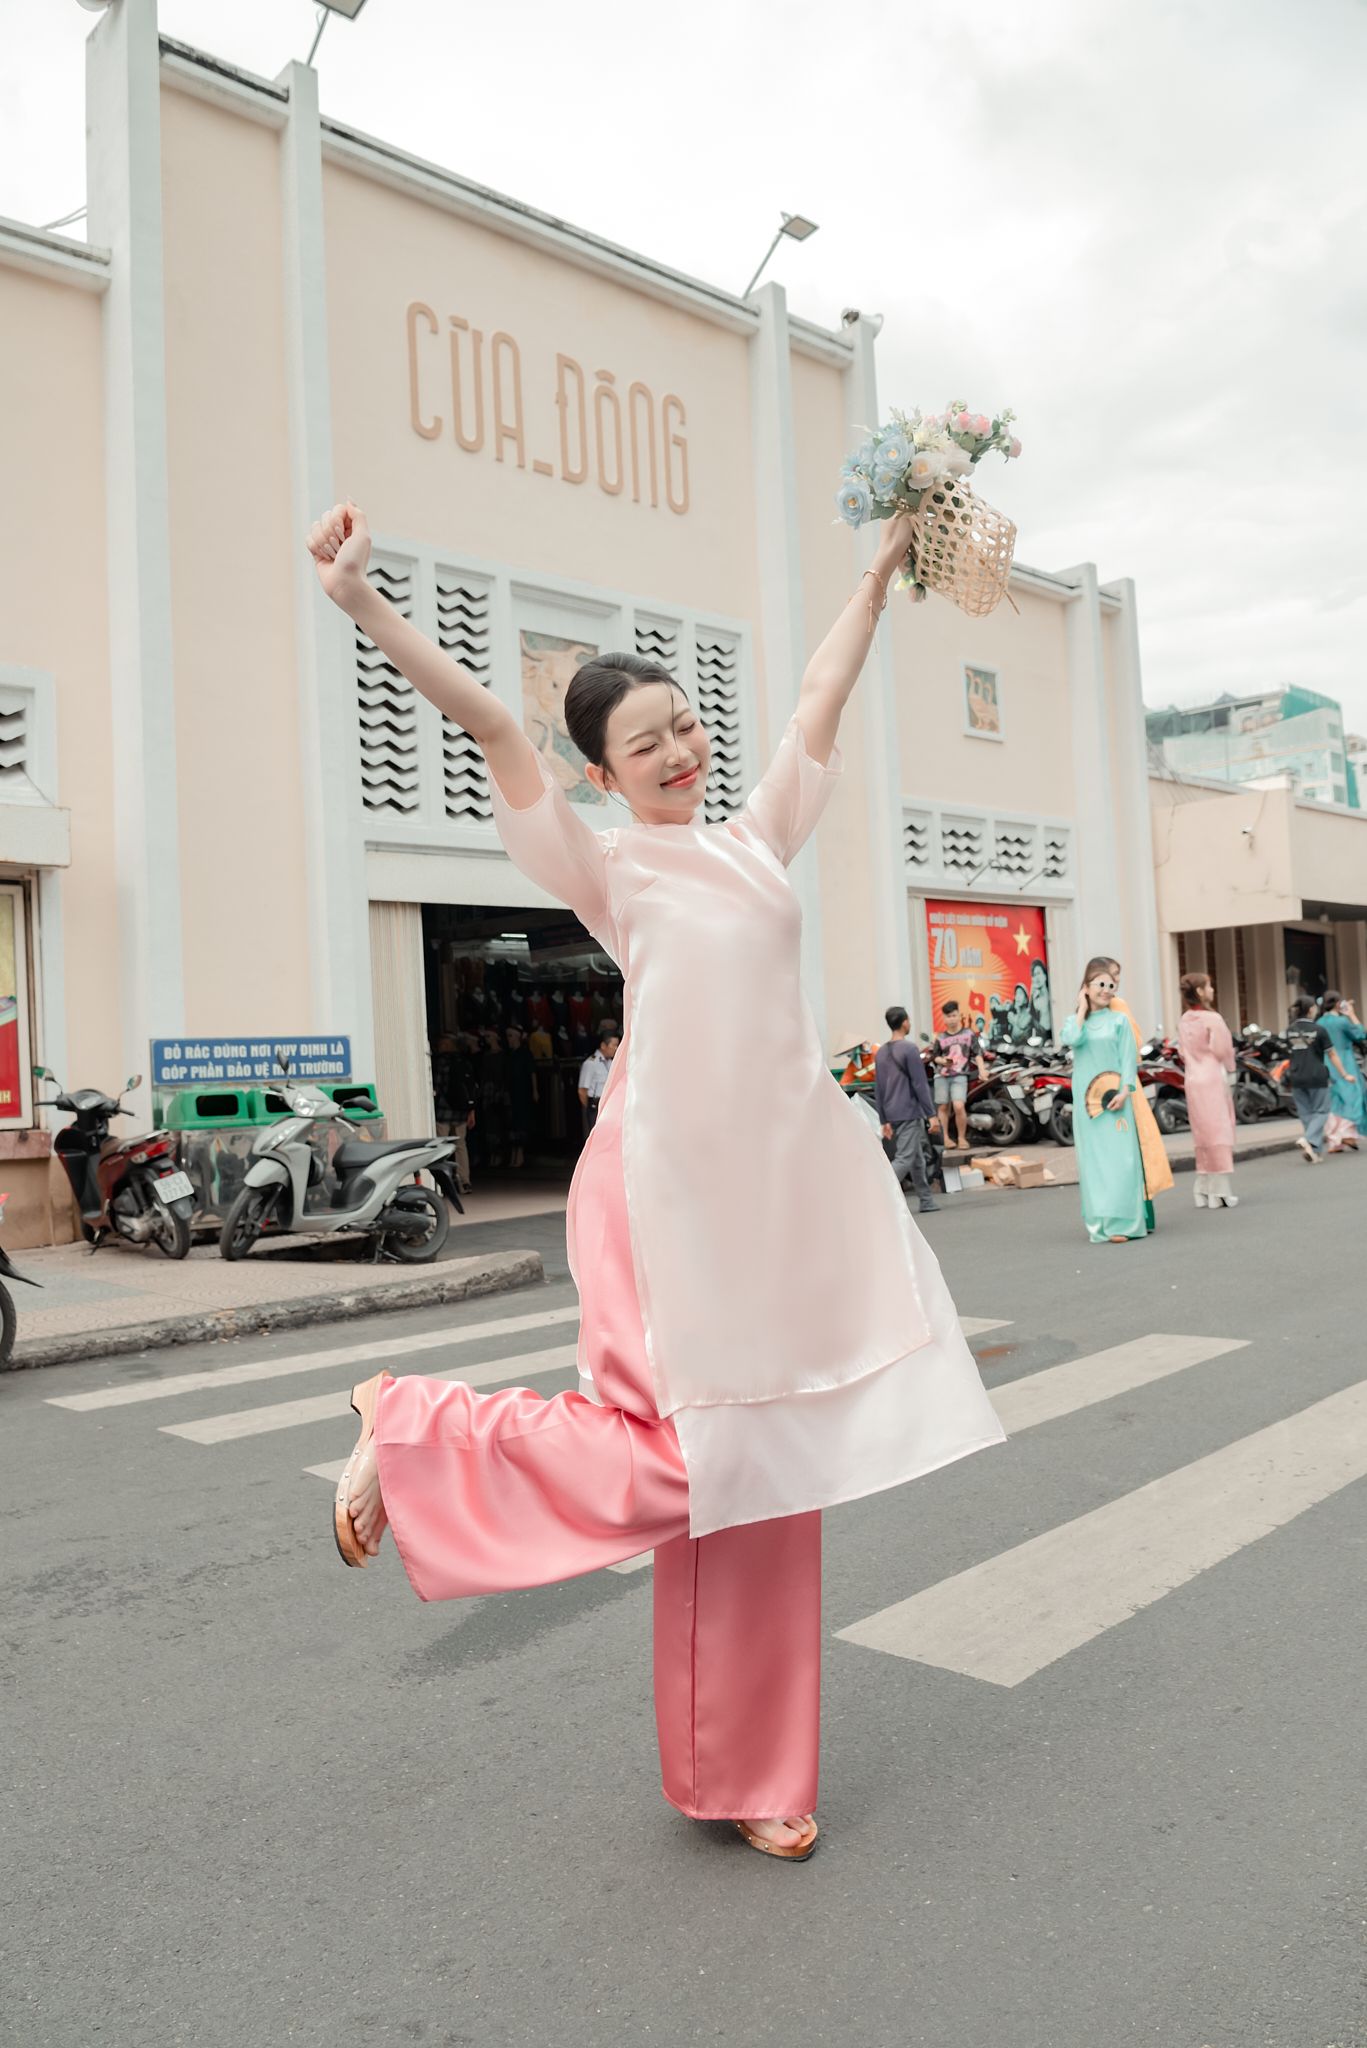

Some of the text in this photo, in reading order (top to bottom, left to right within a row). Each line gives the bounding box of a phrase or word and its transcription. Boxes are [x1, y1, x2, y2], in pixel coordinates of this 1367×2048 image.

[931, 928, 957, 968] 70
[185, 1043, 210, 1059] RÁC
[162, 1064, 188, 1080] GÓP
[227, 1061, 251, 1078] BẢO
